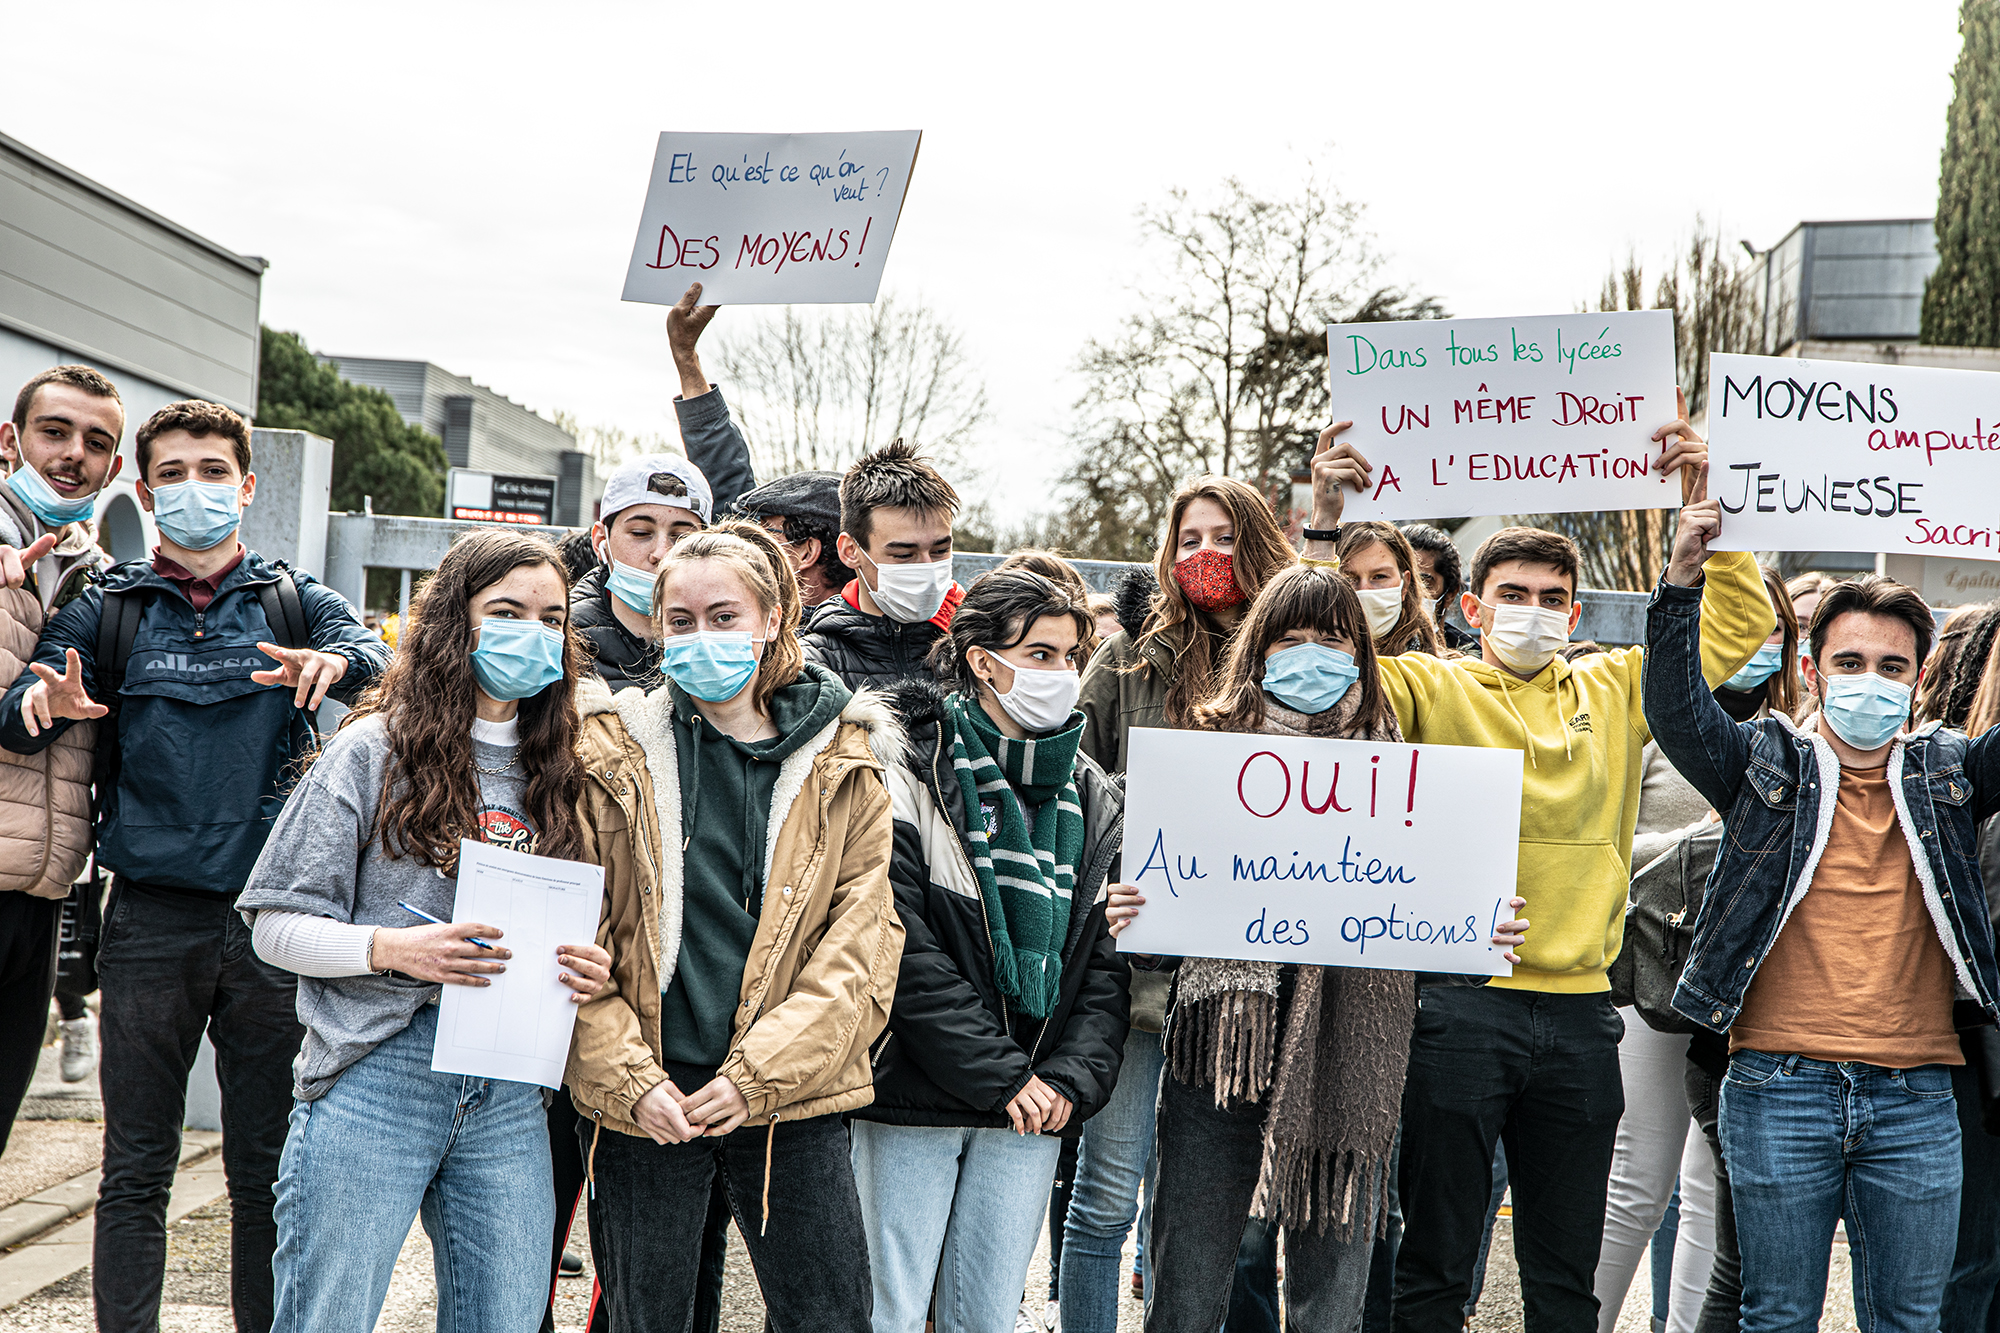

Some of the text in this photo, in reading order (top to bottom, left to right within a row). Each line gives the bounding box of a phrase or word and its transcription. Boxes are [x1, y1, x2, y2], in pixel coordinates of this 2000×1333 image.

[669, 149, 865, 190] Et qu'est ce qu'on
[833, 178, 869, 202] veut
[646, 225, 719, 269] DES
[1347, 327, 1622, 375] Dans tous les lycées
[1382, 405, 1430, 434] UN
[1454, 383, 1536, 424] MÊME
[1722, 375, 1898, 424] MOYENS
[1372, 465, 1401, 501] A
[1719, 462, 1923, 518] JEUNESSE
[145, 653, 263, 680] ellesse
[489, 821, 512, 834] the
[1135, 828, 1416, 898] Au maintien
[1246, 907, 1309, 945] des
